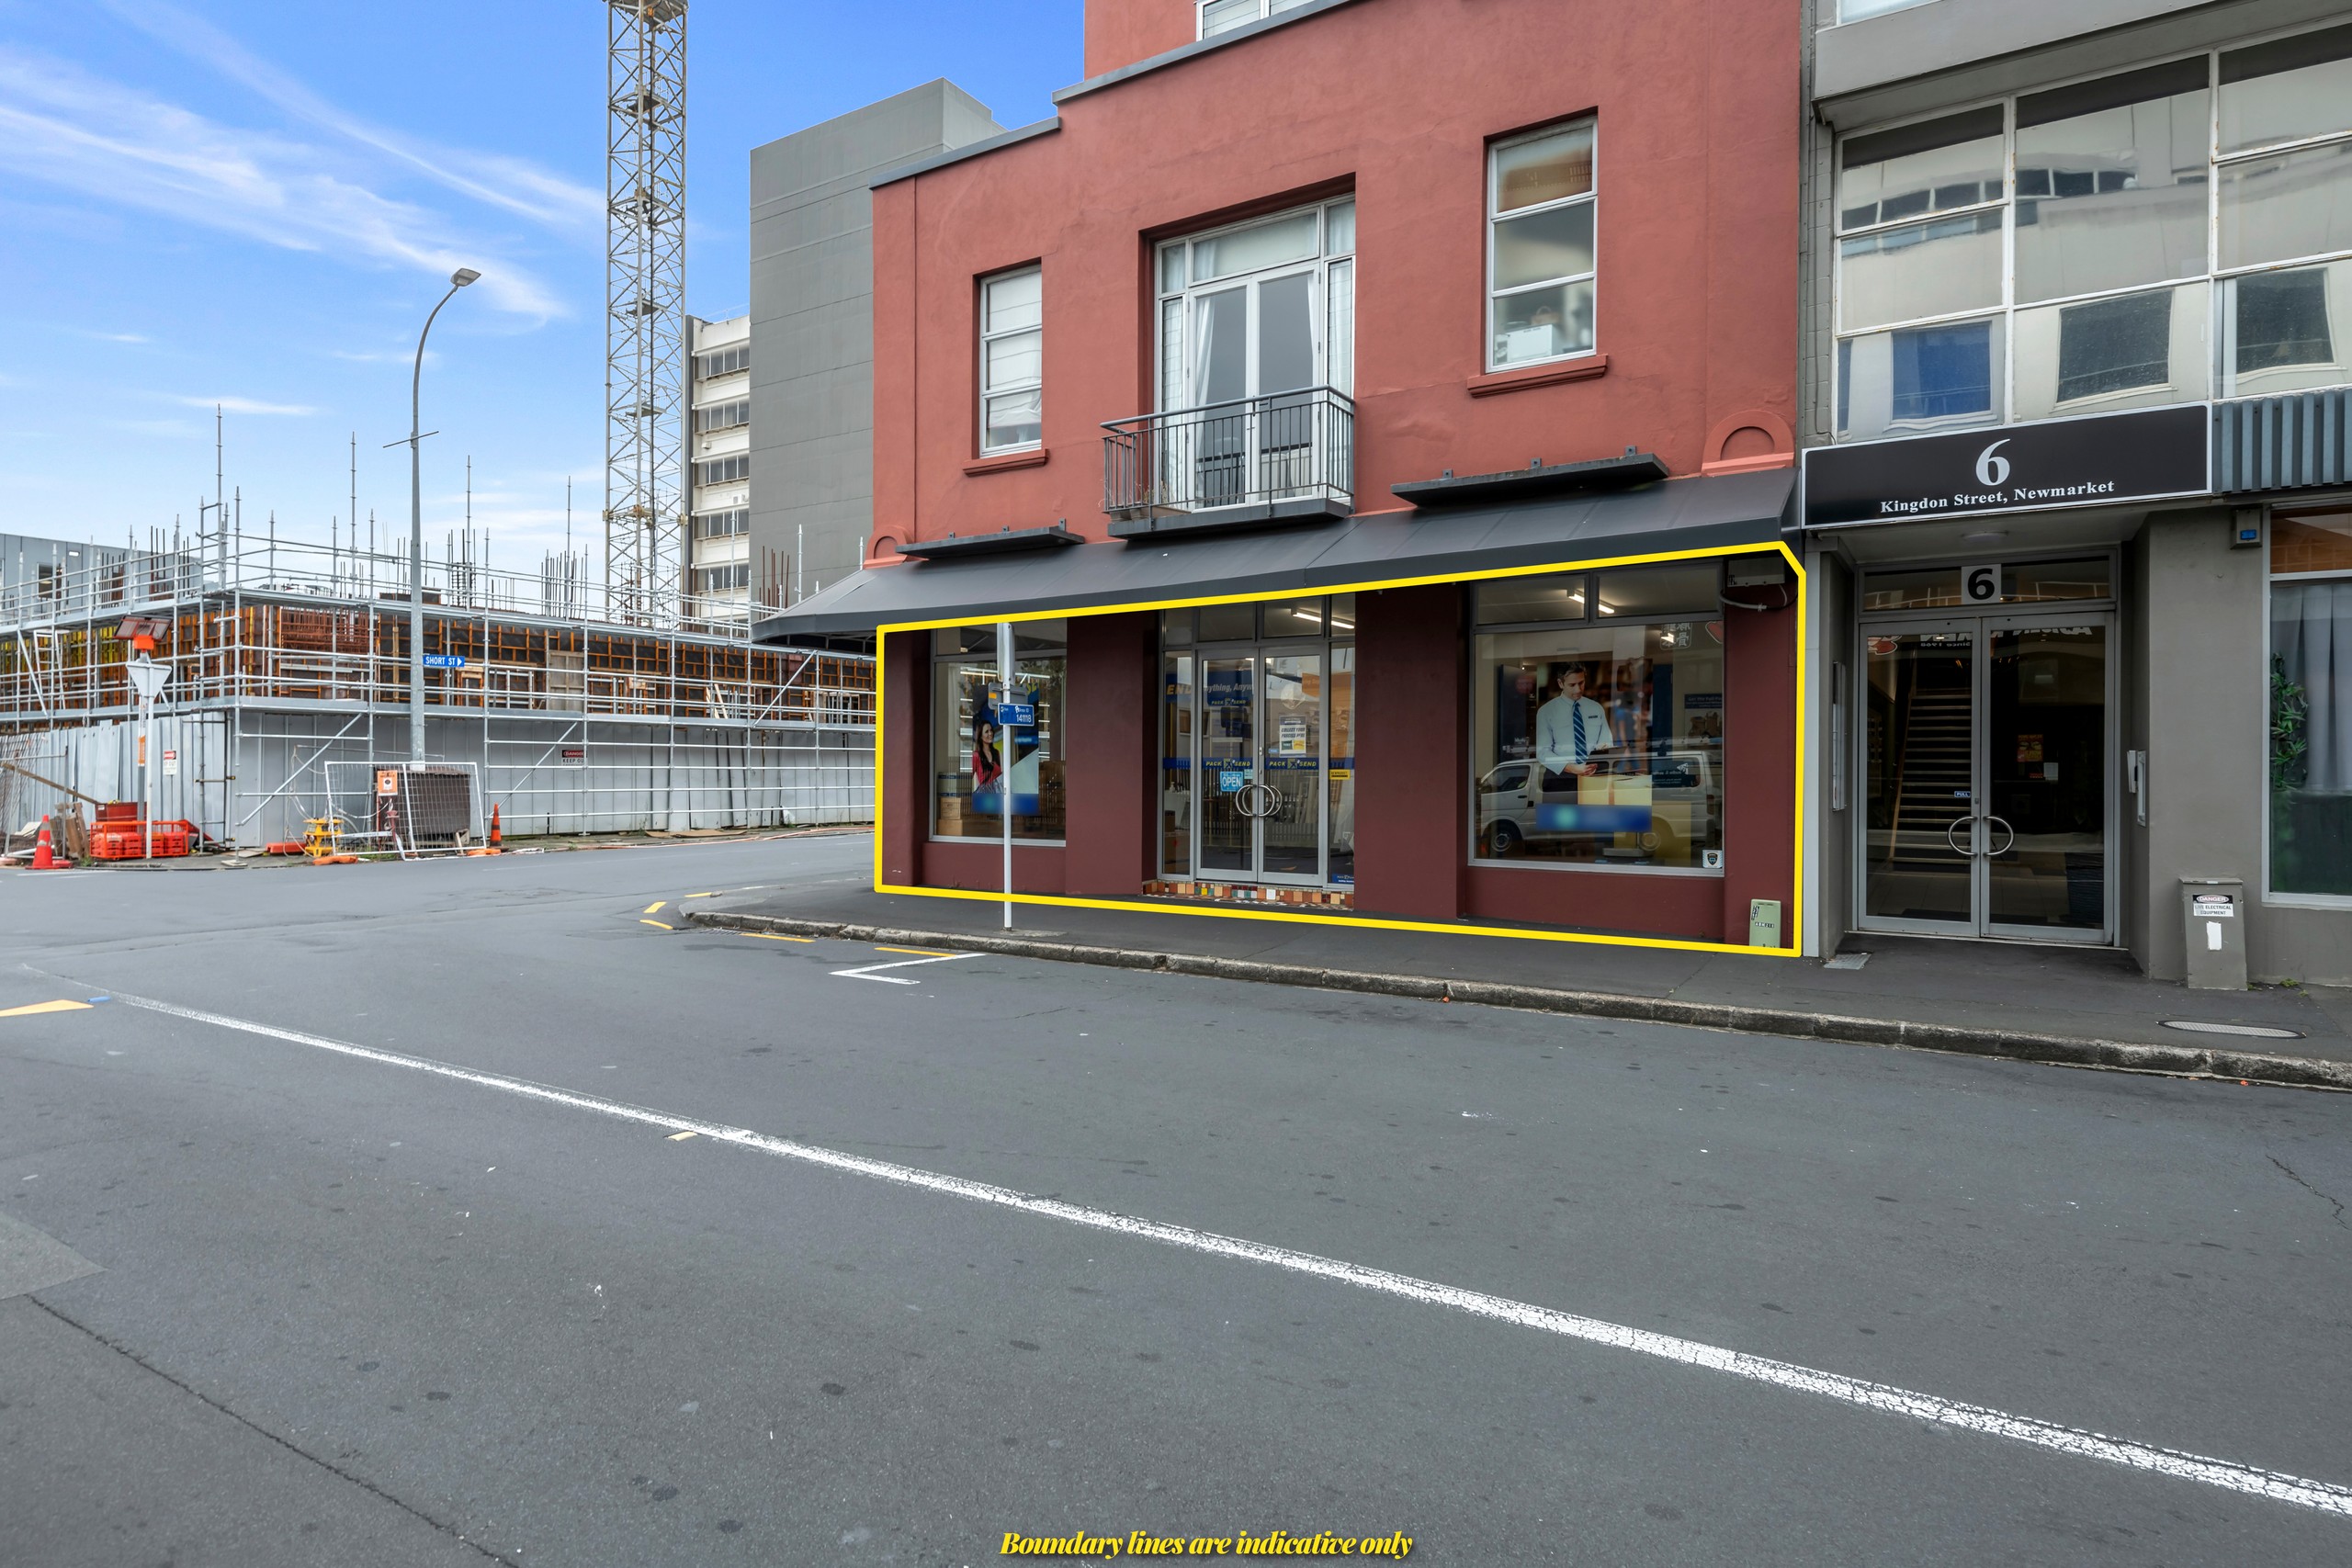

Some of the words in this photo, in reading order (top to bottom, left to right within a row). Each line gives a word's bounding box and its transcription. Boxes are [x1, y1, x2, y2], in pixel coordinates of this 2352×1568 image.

[1975, 438, 2011, 486] 6
[1881, 497, 1948, 513] Kingdon
[1953, 491, 2008, 507] Street,
[2013, 480, 2115, 501] Newmarket
[1968, 568, 1995, 600] 6
[425, 656, 446, 665] SHORT
[448, 657, 456, 665] ST
[1222, 776, 1241, 787] OPEN
